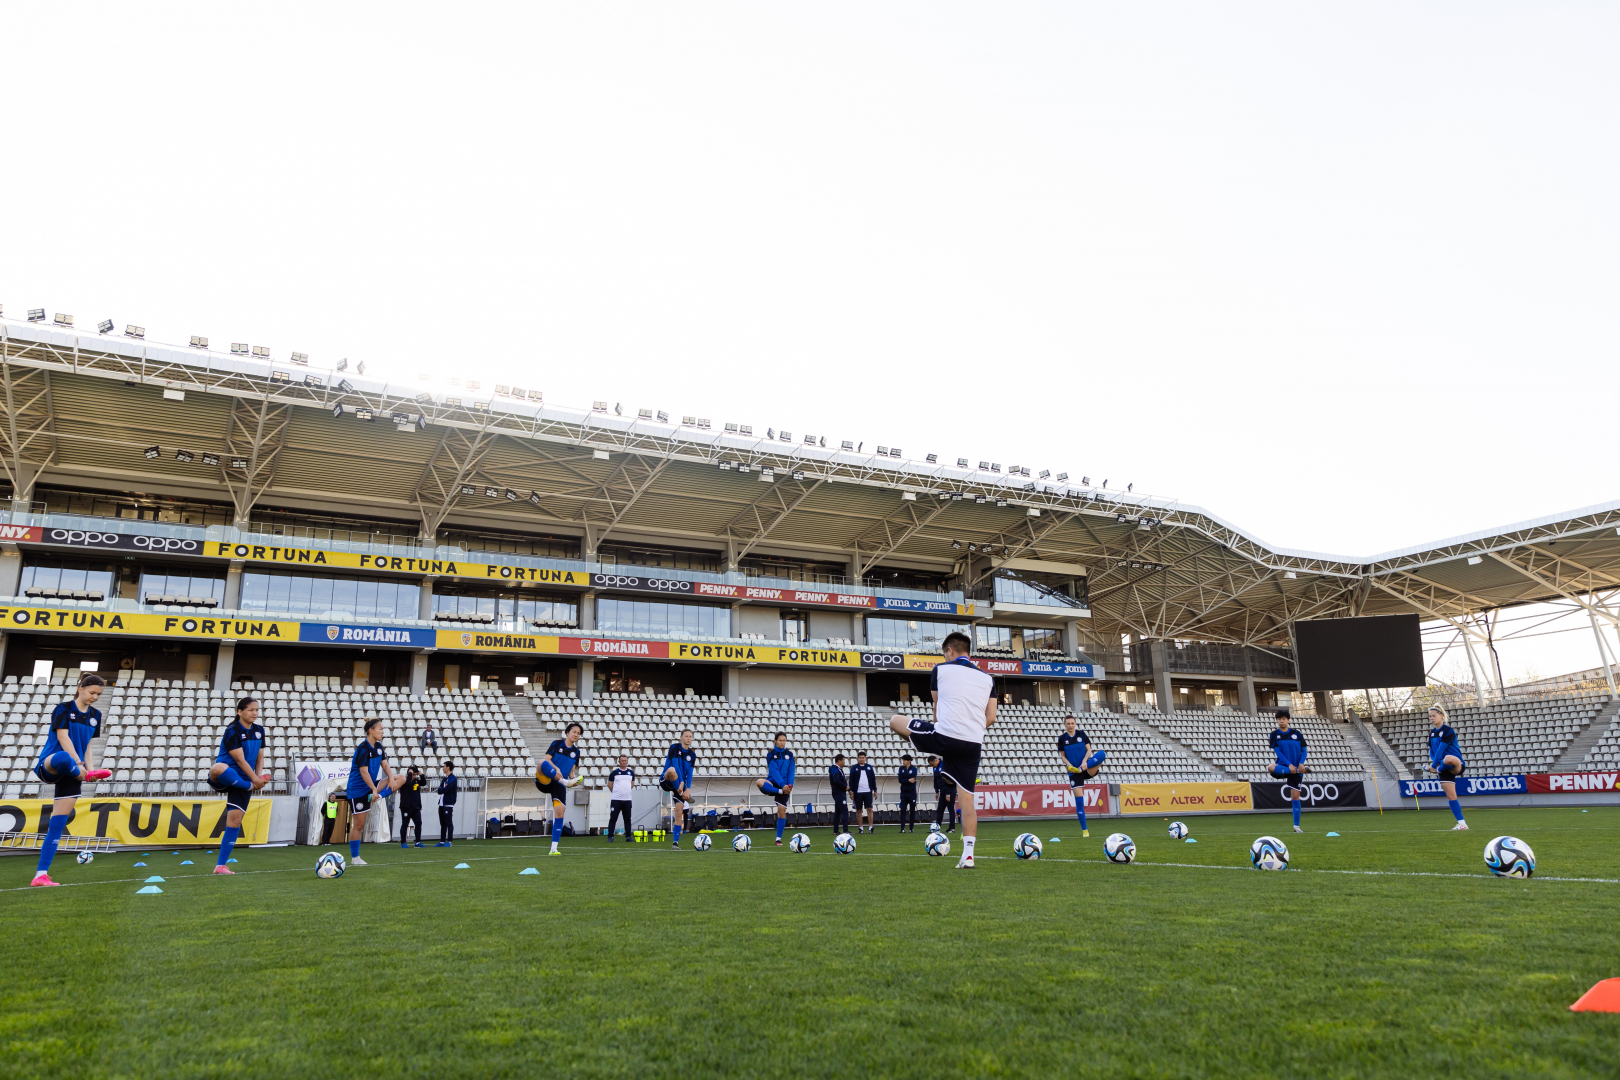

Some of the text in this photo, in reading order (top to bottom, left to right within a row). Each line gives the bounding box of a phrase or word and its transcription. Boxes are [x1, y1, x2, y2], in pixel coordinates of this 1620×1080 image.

[51, 529, 197, 551] oppo oppo
[218, 542, 575, 583] FORTUNA FORTUNA FORTUNA
[594, 574, 690, 591] oppo oppo
[165, 617, 281, 637] FORTUNA
[343, 627, 411, 643] ROMÂNIA
[475, 633, 536, 649] ROMÂNIA
[594, 640, 649, 654] ROMÂNIA
[679, 644, 849, 664] FORTUNA FORTUNA
[863, 653, 902, 666] oppo
[1405, 780, 1445, 796] Jom
